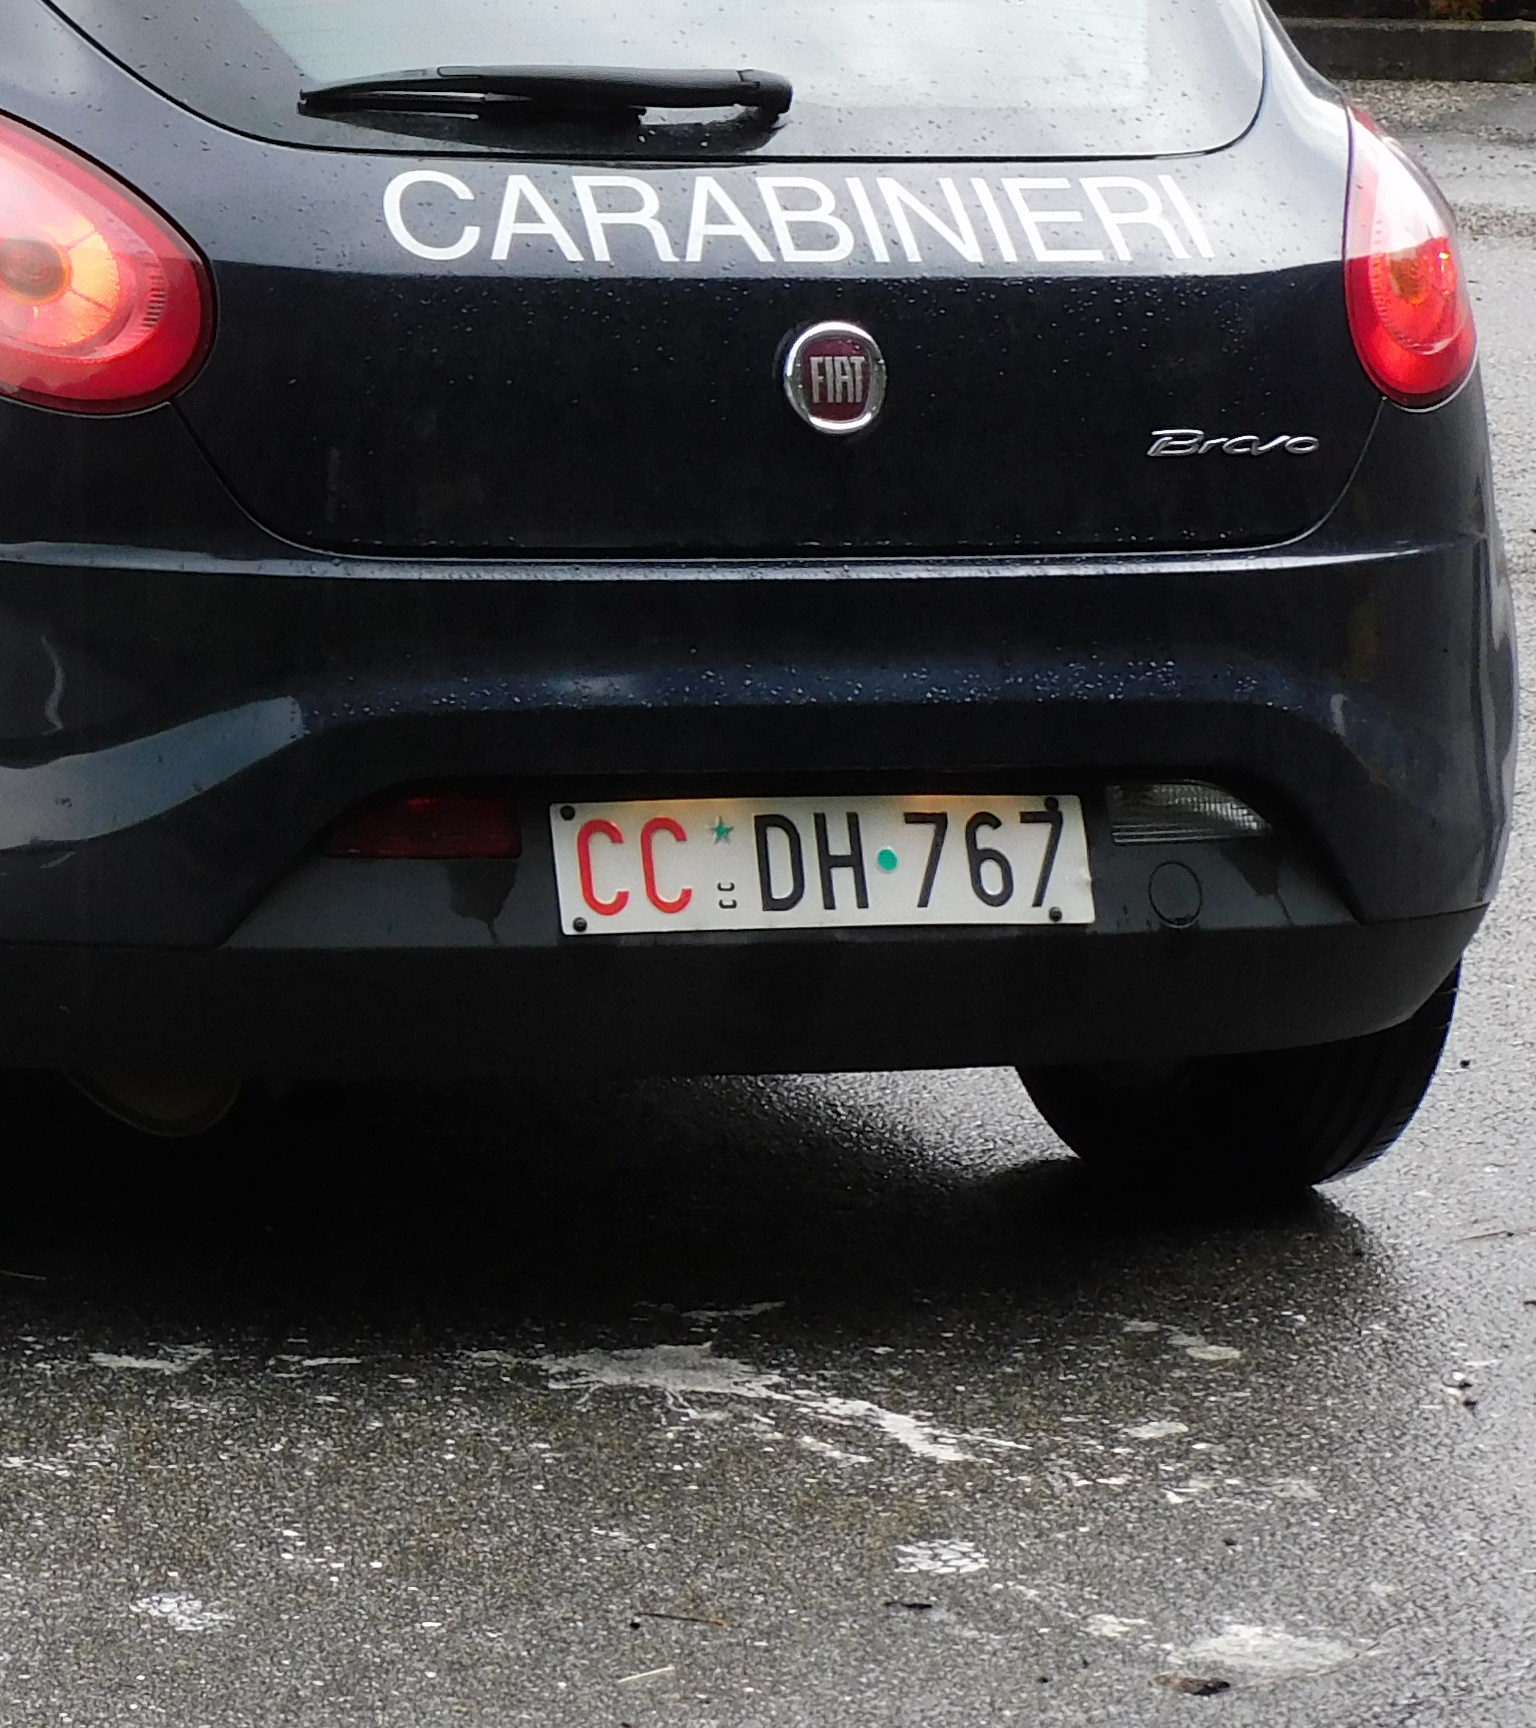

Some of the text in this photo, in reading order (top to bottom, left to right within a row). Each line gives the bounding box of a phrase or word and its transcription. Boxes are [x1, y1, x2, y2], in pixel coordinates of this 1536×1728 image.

[381, 170, 1215, 264] CARABINIERI
[809, 356, 866, 403] FIAT
[1147, 429, 1320, 457] Bravo
[575, 810, 1064, 915] CC DH 767
